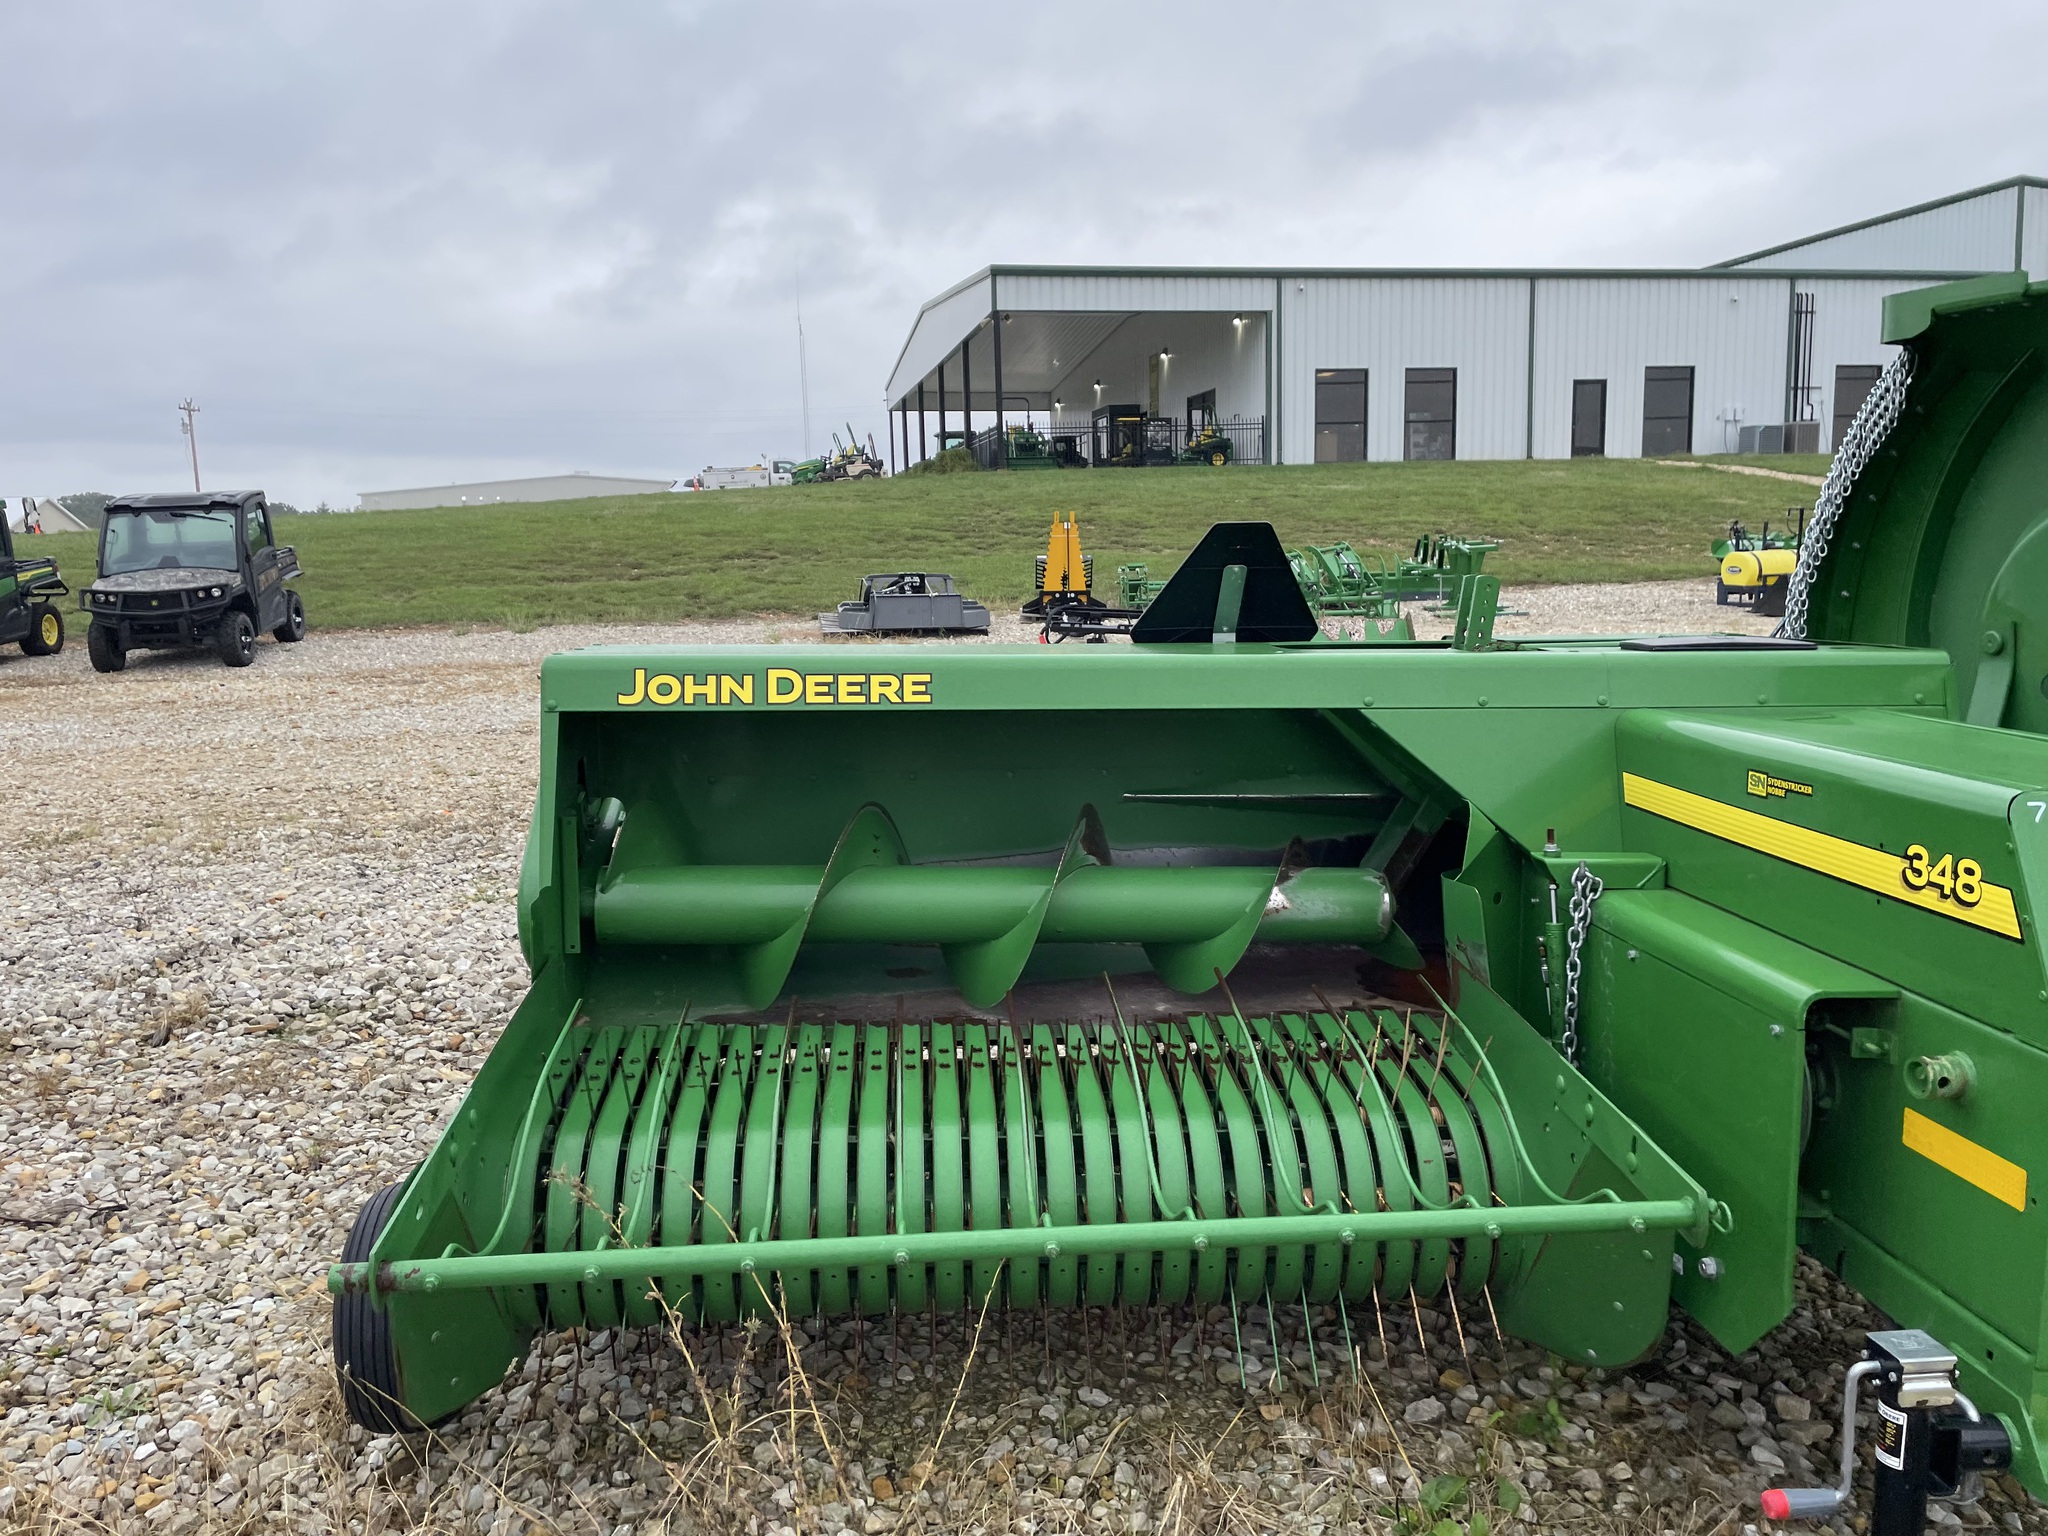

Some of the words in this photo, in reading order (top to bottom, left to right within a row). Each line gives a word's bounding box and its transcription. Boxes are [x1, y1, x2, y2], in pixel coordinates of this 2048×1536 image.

[617, 668, 755, 706] JOHN
[766, 668, 933, 705] DEERE
[1749, 773, 1766, 789] SN
[1767, 777, 1813, 795] SYDENSTRICKER
[2026, 801, 2047, 824] 7
[1902, 844, 1982, 907] 348
